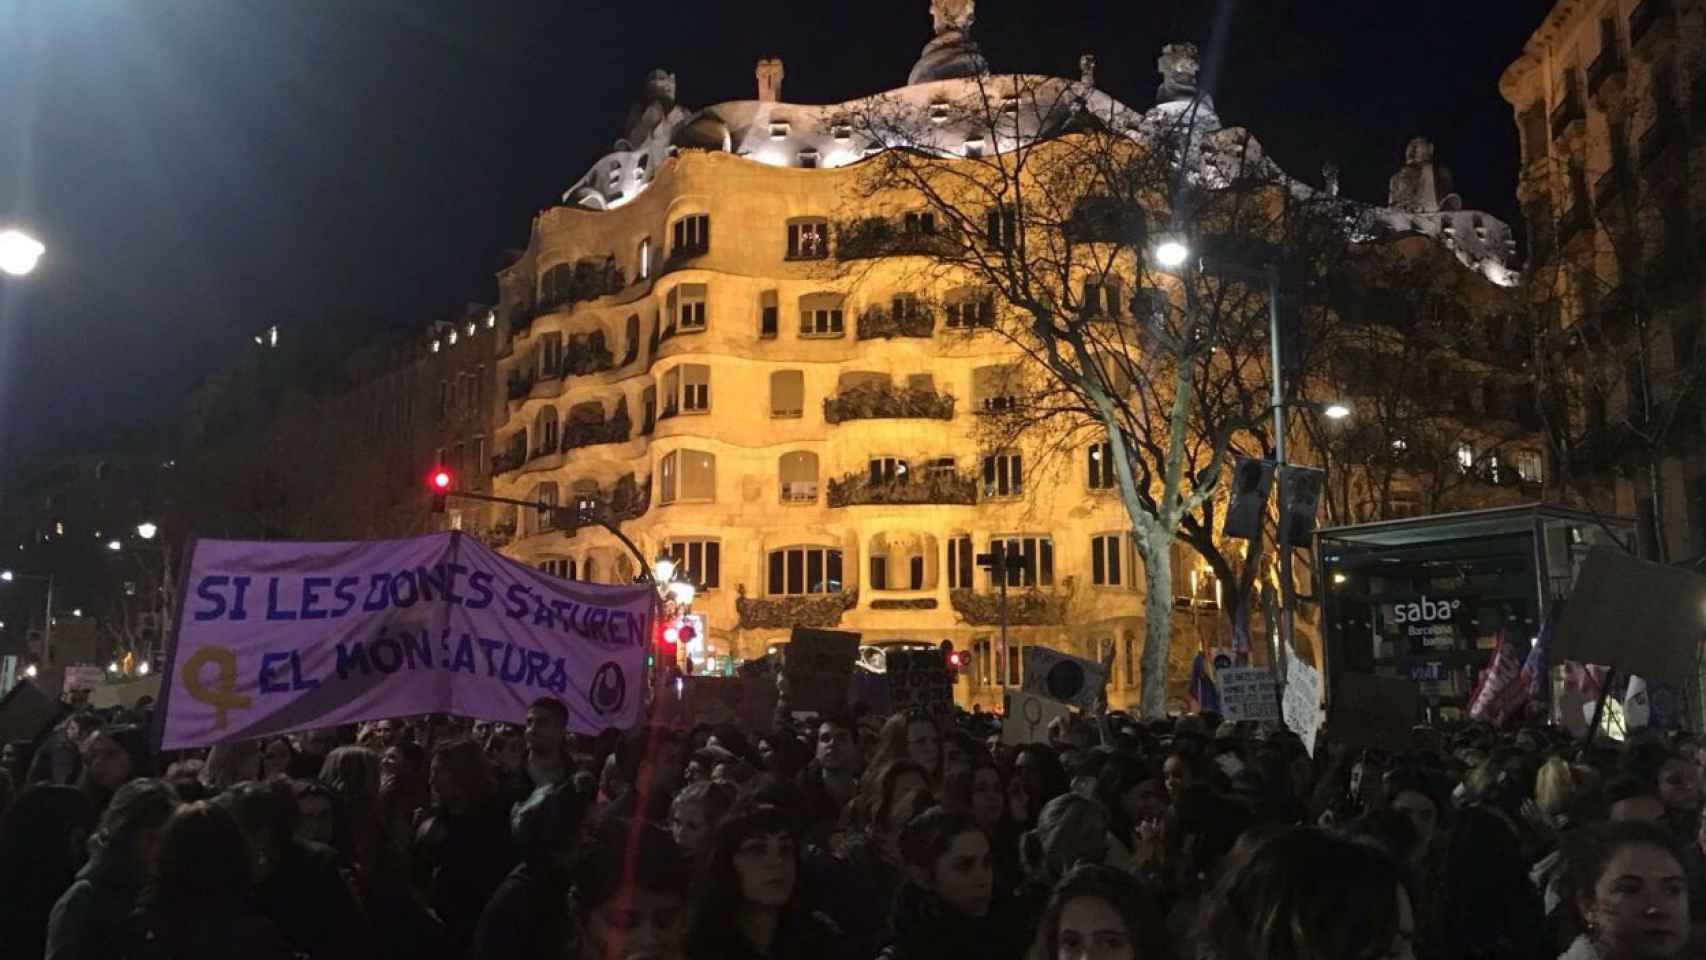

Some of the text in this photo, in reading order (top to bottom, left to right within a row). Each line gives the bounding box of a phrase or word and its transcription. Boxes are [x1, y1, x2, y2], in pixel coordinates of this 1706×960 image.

[194, 575, 252, 621] SI
[266, 575, 360, 620] LES
[259, 650, 321, 694] EL
[335, 626, 433, 681] MÓN
